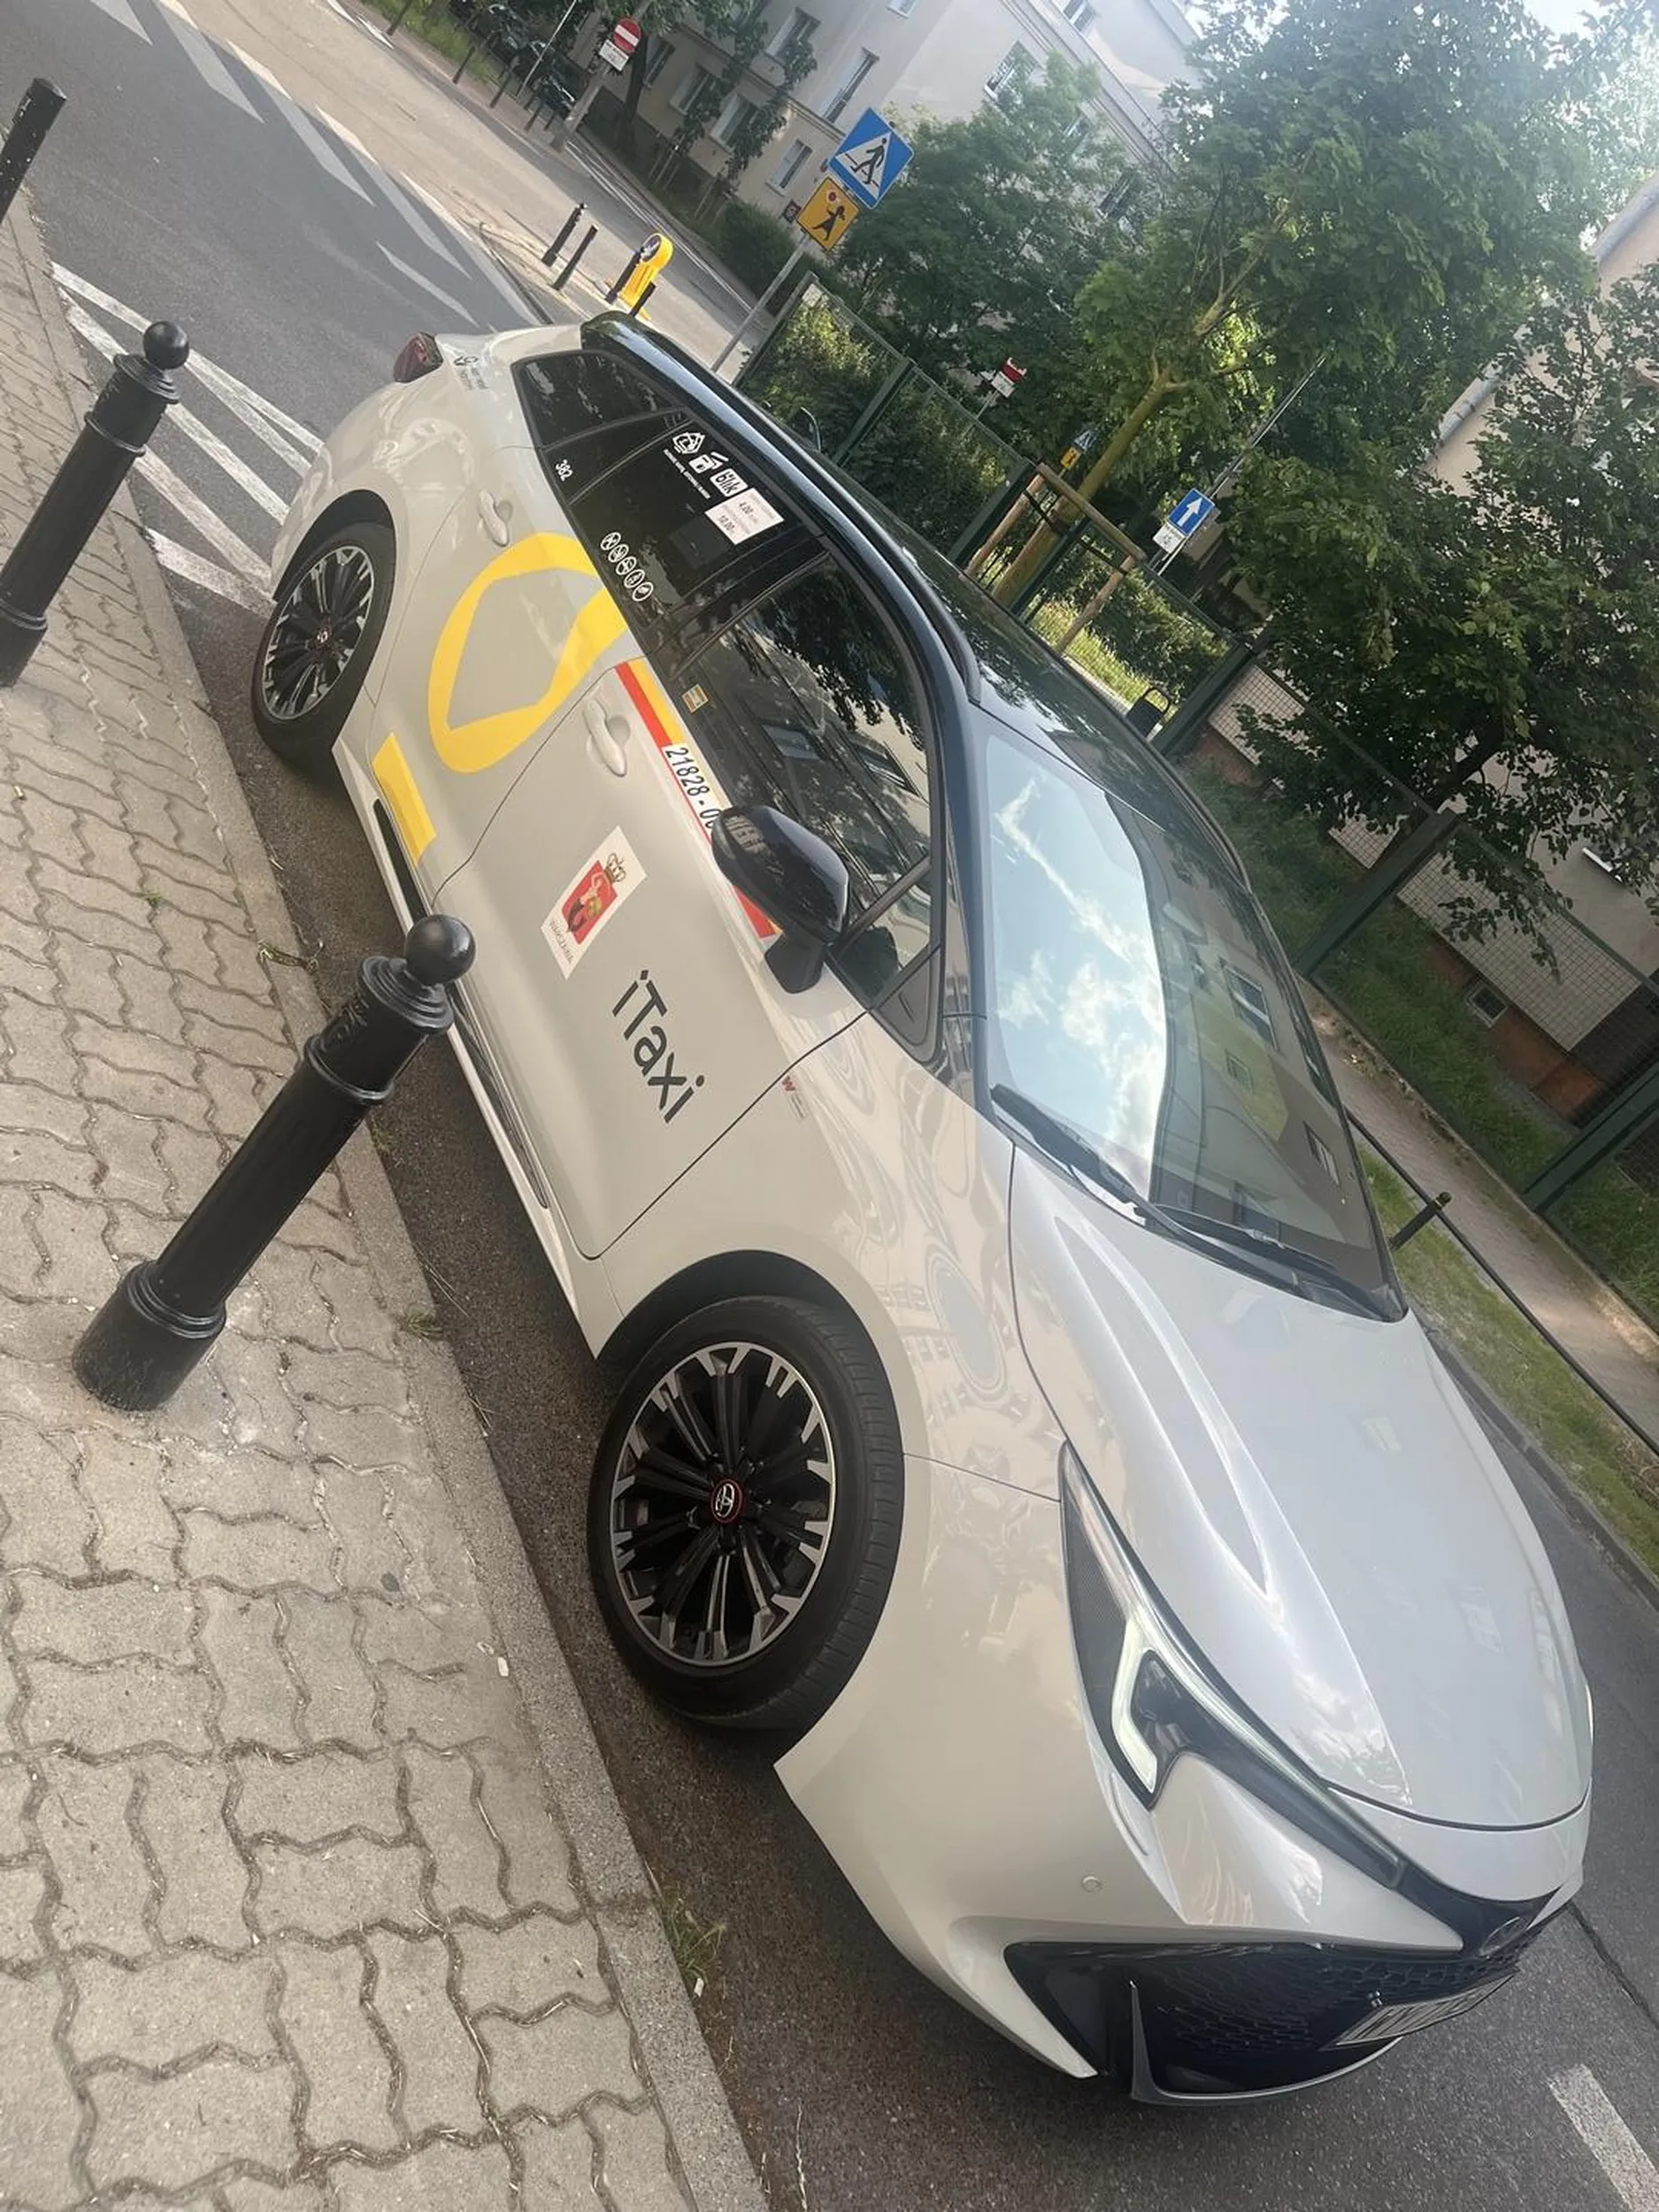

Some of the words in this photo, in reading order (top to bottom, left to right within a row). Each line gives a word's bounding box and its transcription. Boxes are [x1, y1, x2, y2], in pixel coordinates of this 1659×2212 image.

[556, 458, 573, 481] 382
[715, 471, 741, 494] blik
[665, 747, 710, 796] 21828
[612, 970, 705, 1124] iTaxi
